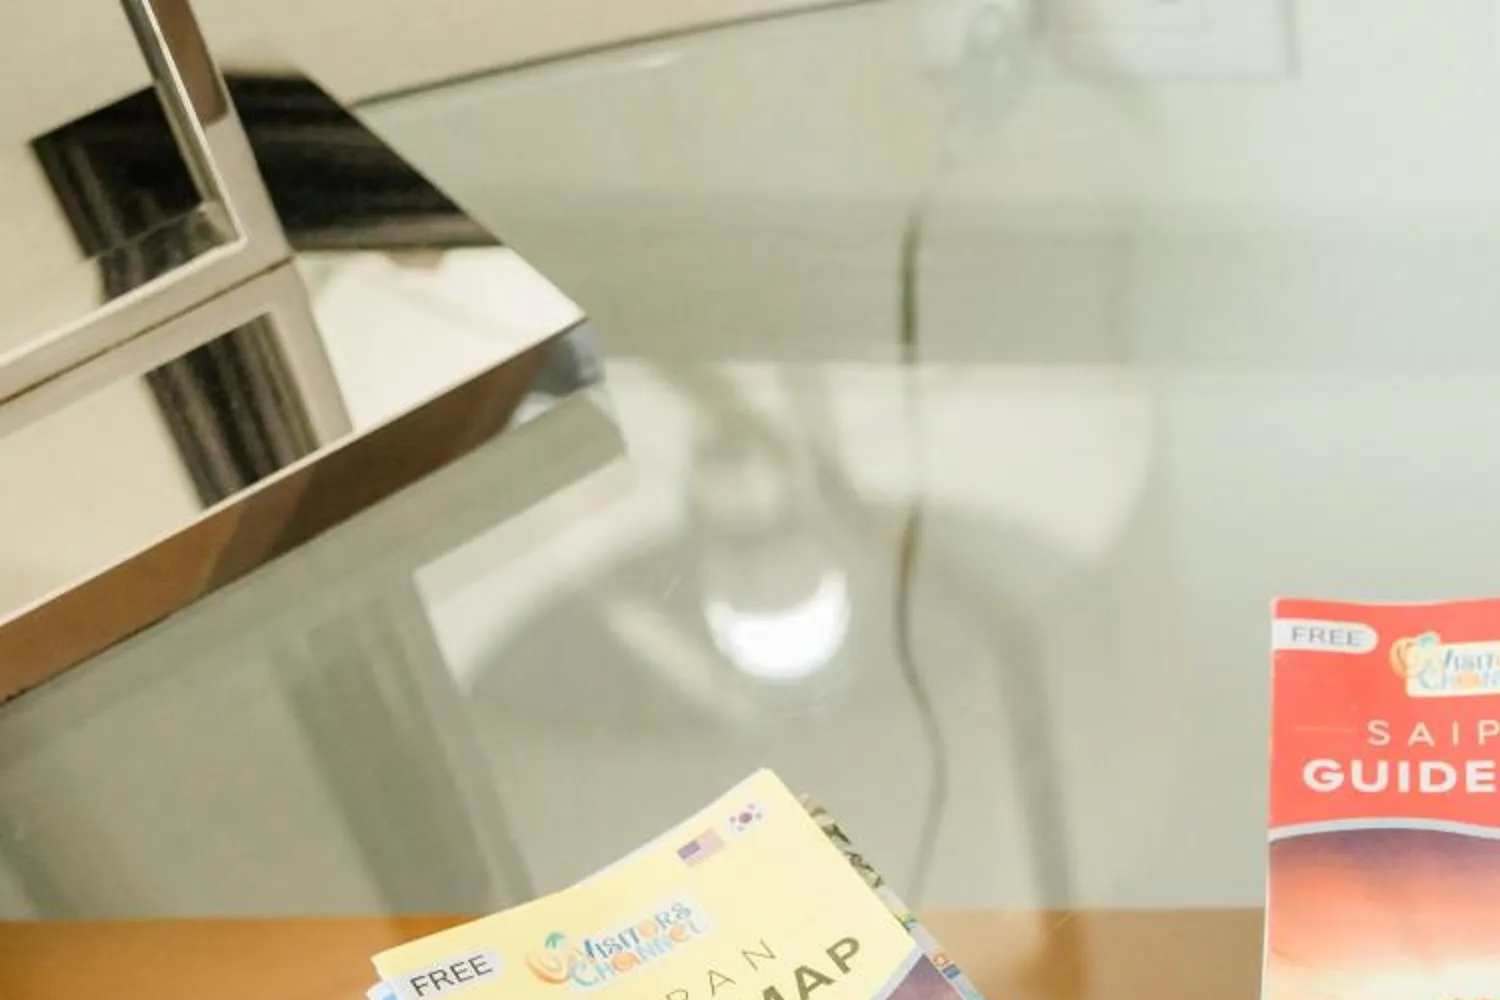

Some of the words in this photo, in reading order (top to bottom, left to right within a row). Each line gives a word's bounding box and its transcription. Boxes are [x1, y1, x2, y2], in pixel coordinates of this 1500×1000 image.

[1291, 626, 1362, 648] FREE
[1303, 758, 1498, 793] GUIDE
[409, 954, 494, 998] FREE
